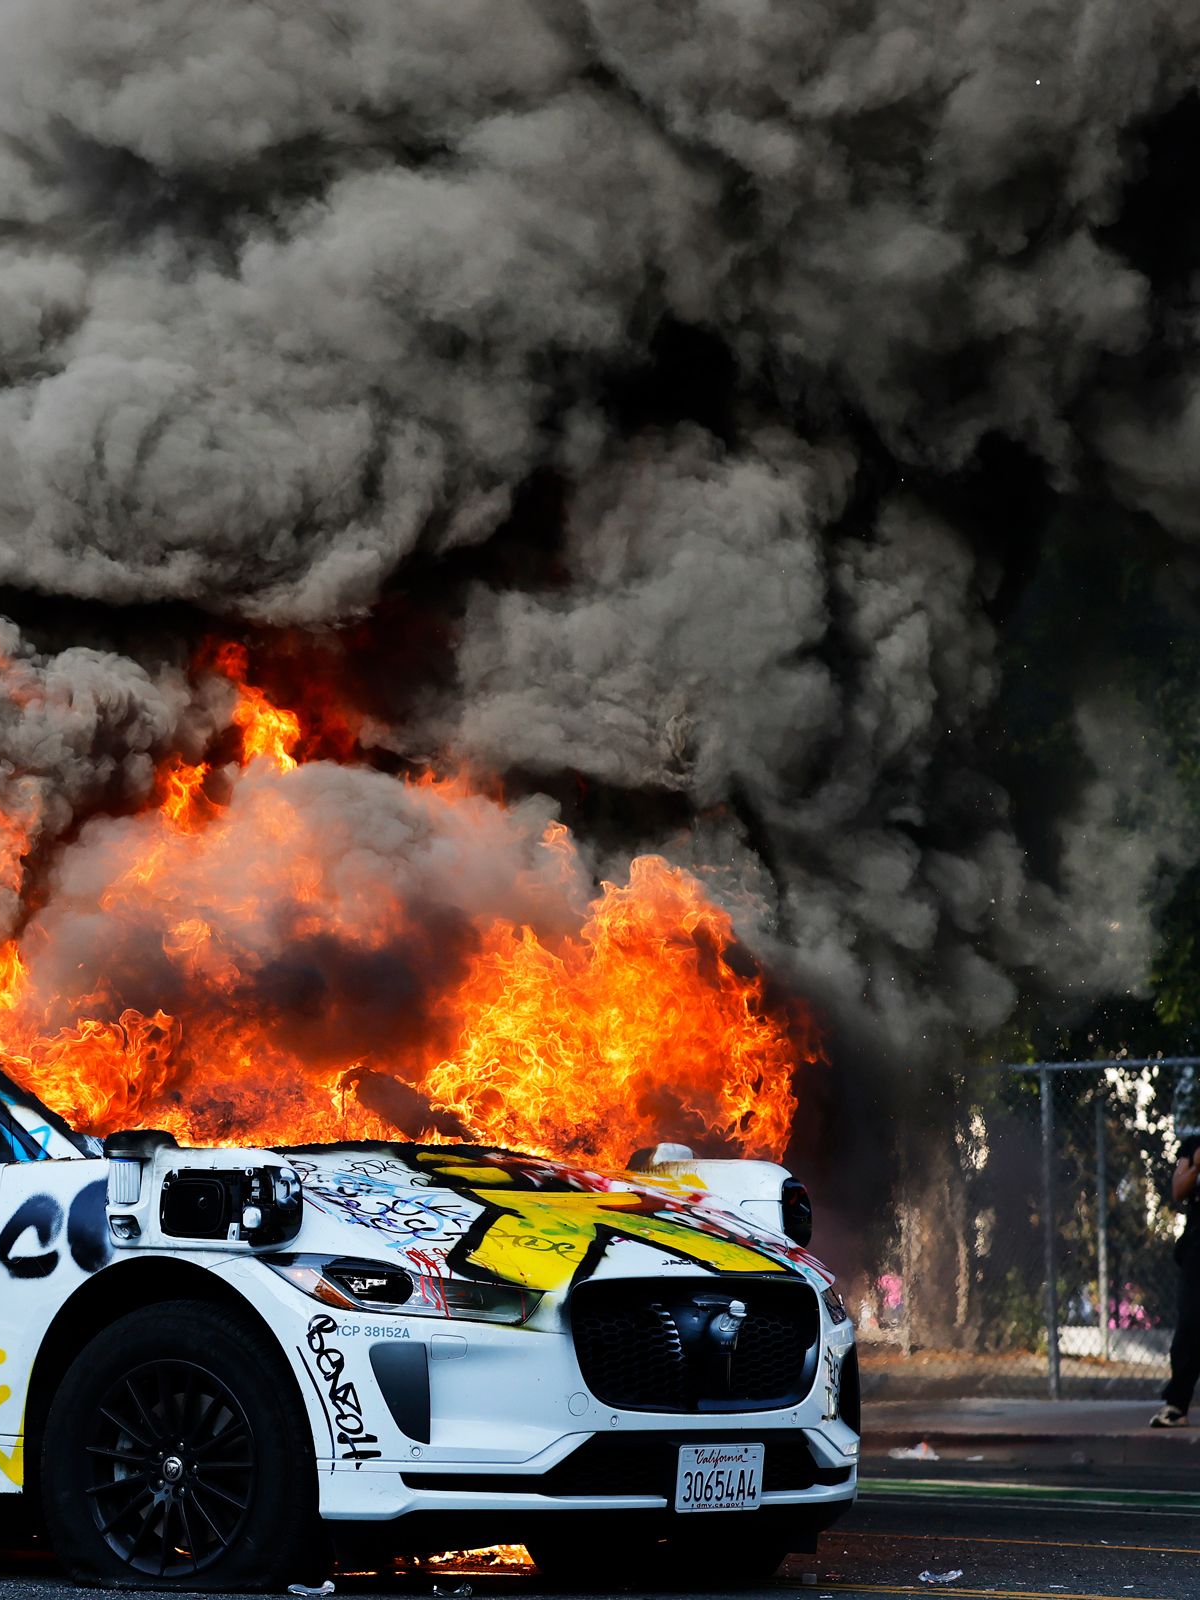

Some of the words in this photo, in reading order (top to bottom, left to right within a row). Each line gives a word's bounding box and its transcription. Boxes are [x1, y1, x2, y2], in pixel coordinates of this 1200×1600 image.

[335, 1325, 361, 1337] TCP
[364, 1326, 411, 1339] 38152A
[696, 1448, 748, 1469] California
[682, 1469, 757, 1503] 30654A4
